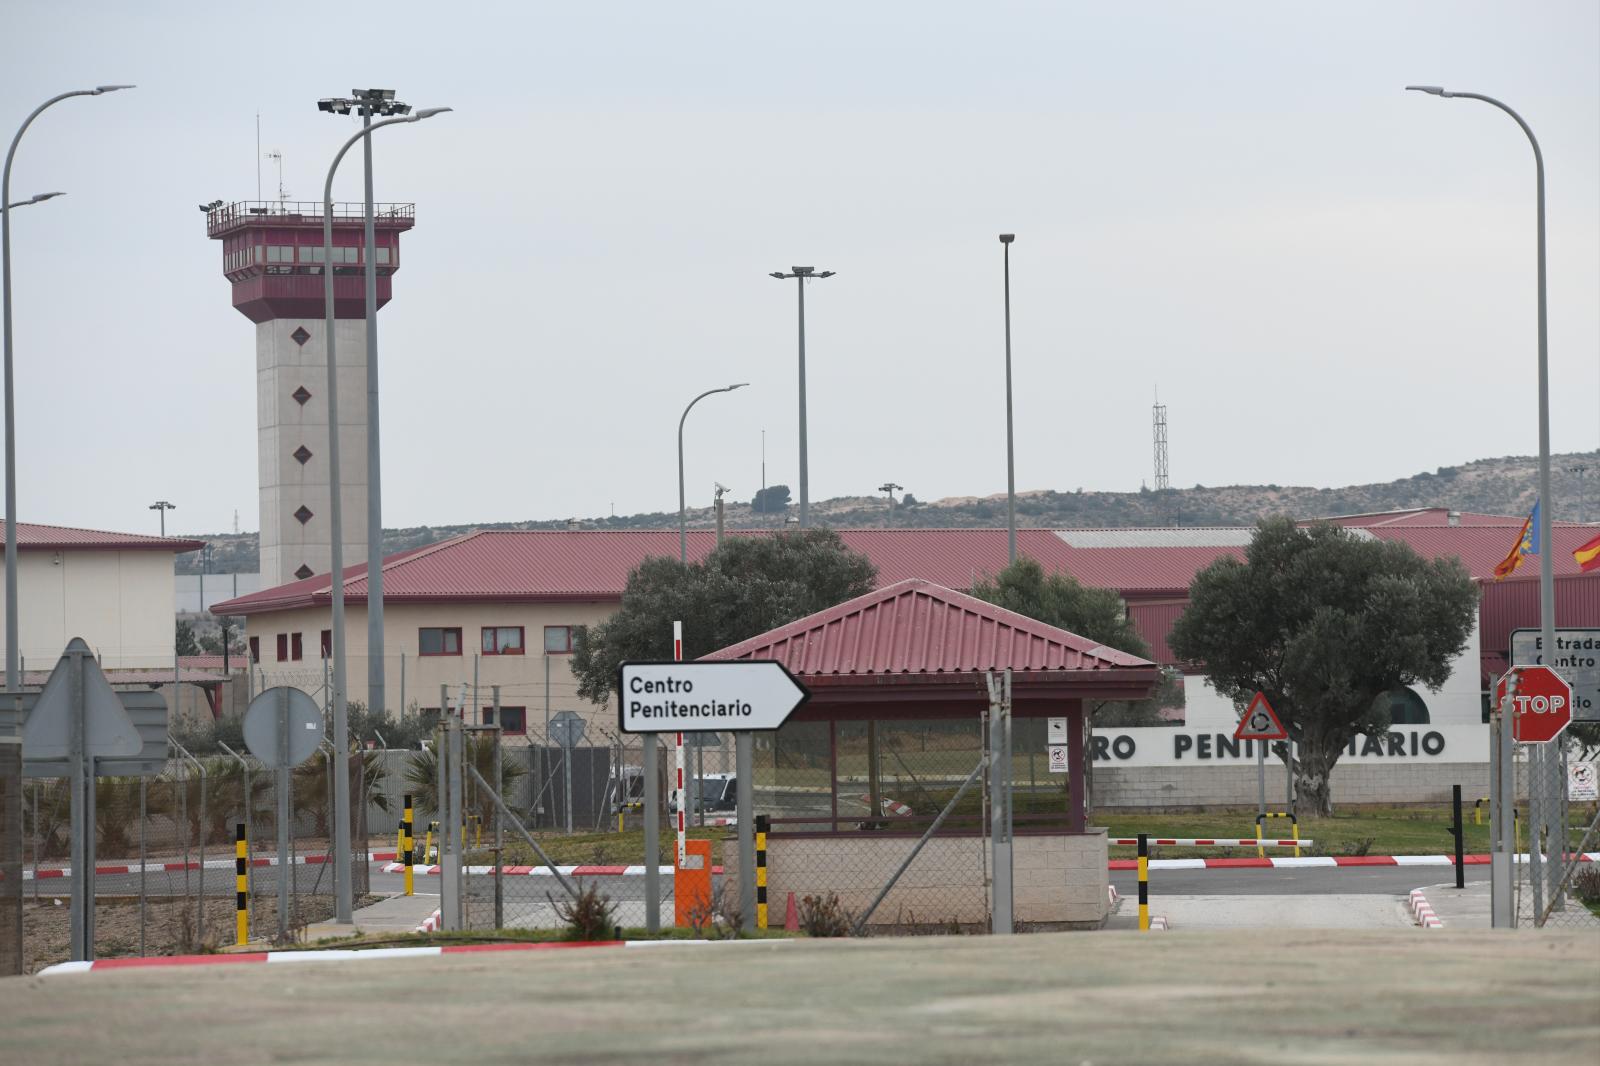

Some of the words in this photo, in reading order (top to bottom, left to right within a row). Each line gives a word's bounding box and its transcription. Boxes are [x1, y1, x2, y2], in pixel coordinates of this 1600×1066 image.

[1536, 637, 1600, 650] Etrada
[1536, 655, 1595, 667] ntro
[630, 676, 693, 694] Centro
[630, 699, 752, 718] Penitenciario
[1174, 731, 1445, 759] PENIIARIO
